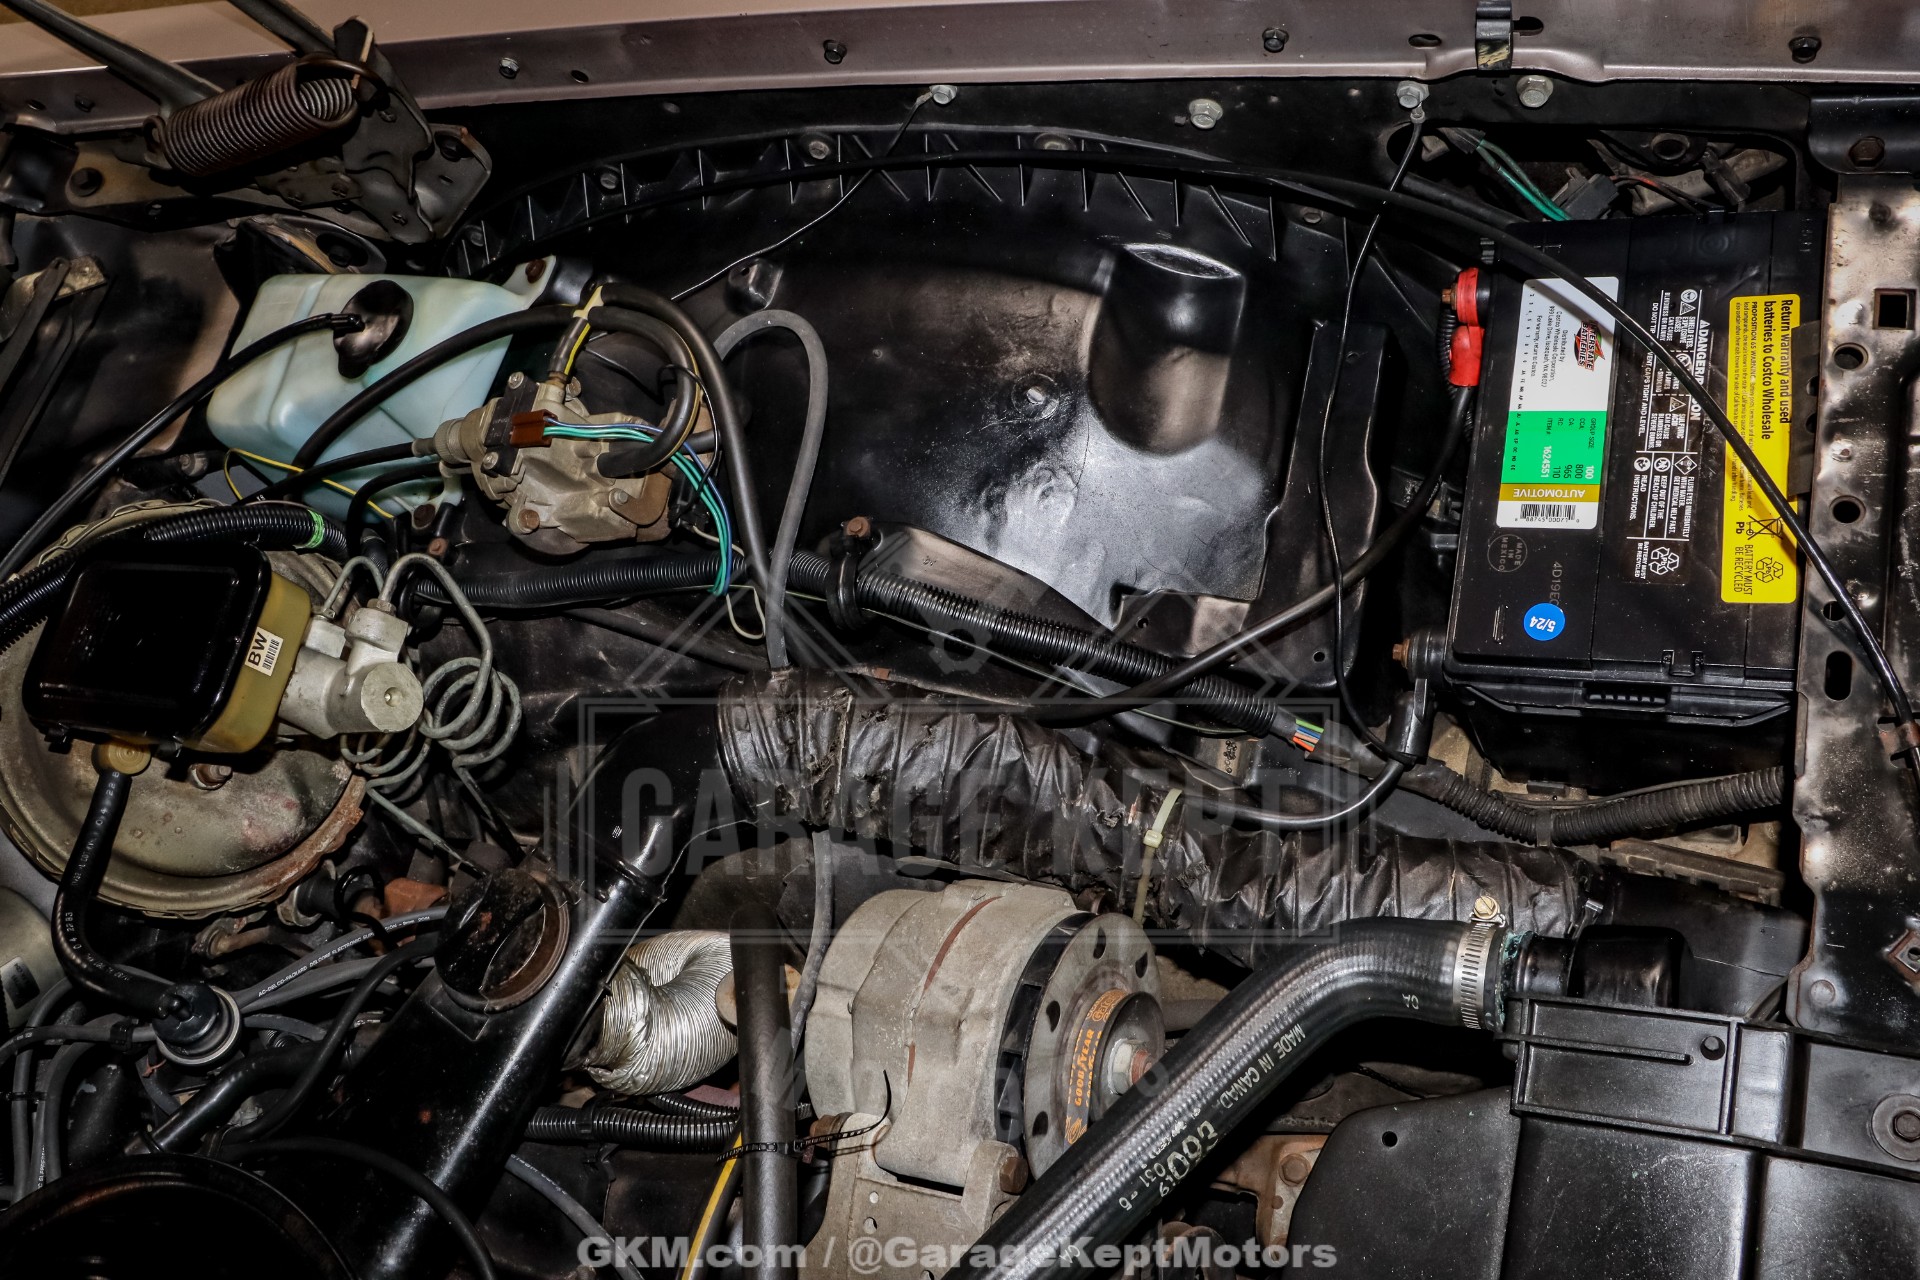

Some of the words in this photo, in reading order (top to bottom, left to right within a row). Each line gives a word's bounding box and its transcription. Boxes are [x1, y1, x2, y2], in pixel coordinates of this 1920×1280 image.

[1652, 302, 1658, 310] DO
[1780, 299, 1793, 331] Return
[1679, 316, 1688, 343] EXPLOSIVE
[1687, 316, 1695, 333] SHIELD
[1762, 300, 1776, 342] batteries
[1577, 322, 1588, 365] BATTERIES
[1763, 344, 1773, 353] to
[1776, 334, 1791, 376] warranty
[1689, 328, 1709, 420] DANGER/PON
[1762, 356, 1774, 385] Costco
[1779, 379, 1791, 397] and
[1649, 412, 1657, 431] SEVERE
[1670, 413, 1678, 426] ACID
[1760, 388, 1775, 439] Wholesale
[1779, 400, 1792, 423] used
[1655, 413, 1664, 439] BLINDNESS
[1662, 423, 1670, 439] CAUSE
[1676, 413, 1685, 438] SULFURIC
[1647, 431, 1655, 449] BURNS.
[1655, 439, 1661, 447] OR
[1540, 445, 1551, 477] 1624551
[1563, 464, 1572, 478] 965
[1574, 463, 1583, 478] 800
[1552, 465, 1561, 478] 110
[1584, 464, 1594, 479] 100
[1512, 486, 1585, 501] AUTOMOTIVE
[1652, 475, 1660, 492] REACH
[1686, 476, 1694, 492] FLUSH
[1629, 474, 1640, 520] INSTRUCTIONS.
[1658, 500, 1664, 508] OF
[1671, 485, 1679, 506] MEDICAL
[1648, 501, 1657, 529] CHILDREN.
[1682, 505, 1691, 537] IMMEDIATELY
[1668, 520, 1676, 534] FAST.
[1735, 521, 1744, 534] Pb
[1498, 536, 1508, 570] MEXICO
[1508, 549, 1514, 558] IN
[1514, 542, 1522, 565] MADE
[1637, 542, 1642, 550] BE
[1735, 546, 1743, 555] BE
[1634, 550, 1642, 577] RECYCLED
[1660, 557, 1667, 565] Pb
[1744, 544, 1753, 573] BATTERY
[1733, 557, 1743, 592] RECYCLED
[1743, 575, 1752, 594] MUST
[1529, 615, 1556, 632] 5/24
[248, 632, 267, 666] BW
[1273, 1023, 1306, 1059] MADE
[1258, 1052, 1275, 1074] IN
[1214, 1066, 1260, 1109] CANAD
